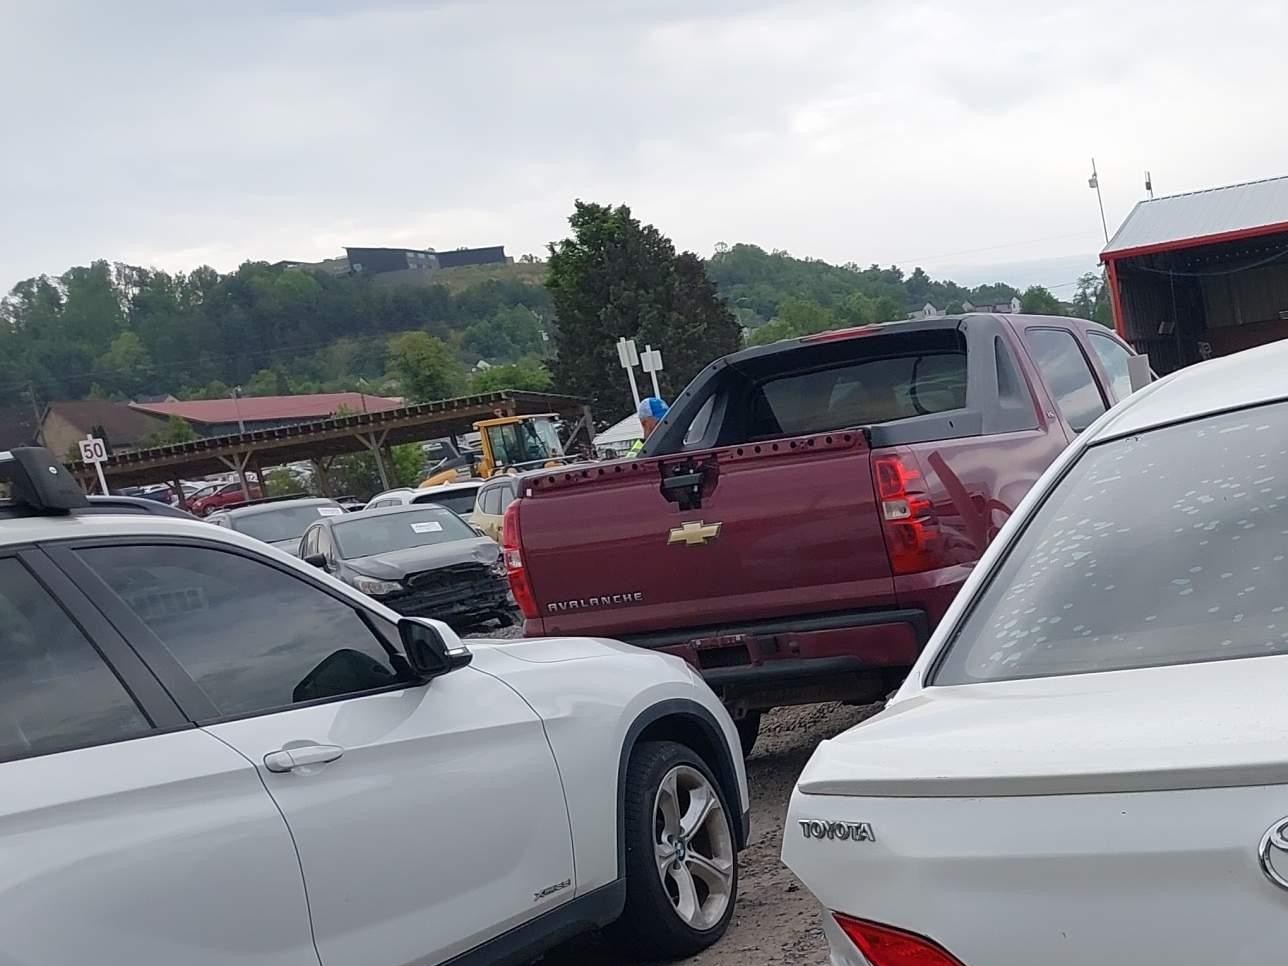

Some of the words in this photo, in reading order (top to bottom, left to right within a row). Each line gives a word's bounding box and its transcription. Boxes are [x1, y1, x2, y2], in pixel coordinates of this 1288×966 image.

[84, 443, 103, 459] 50
[547, 592, 643, 613] AVALANCHE
[798, 819, 876, 842] TOYOTA
